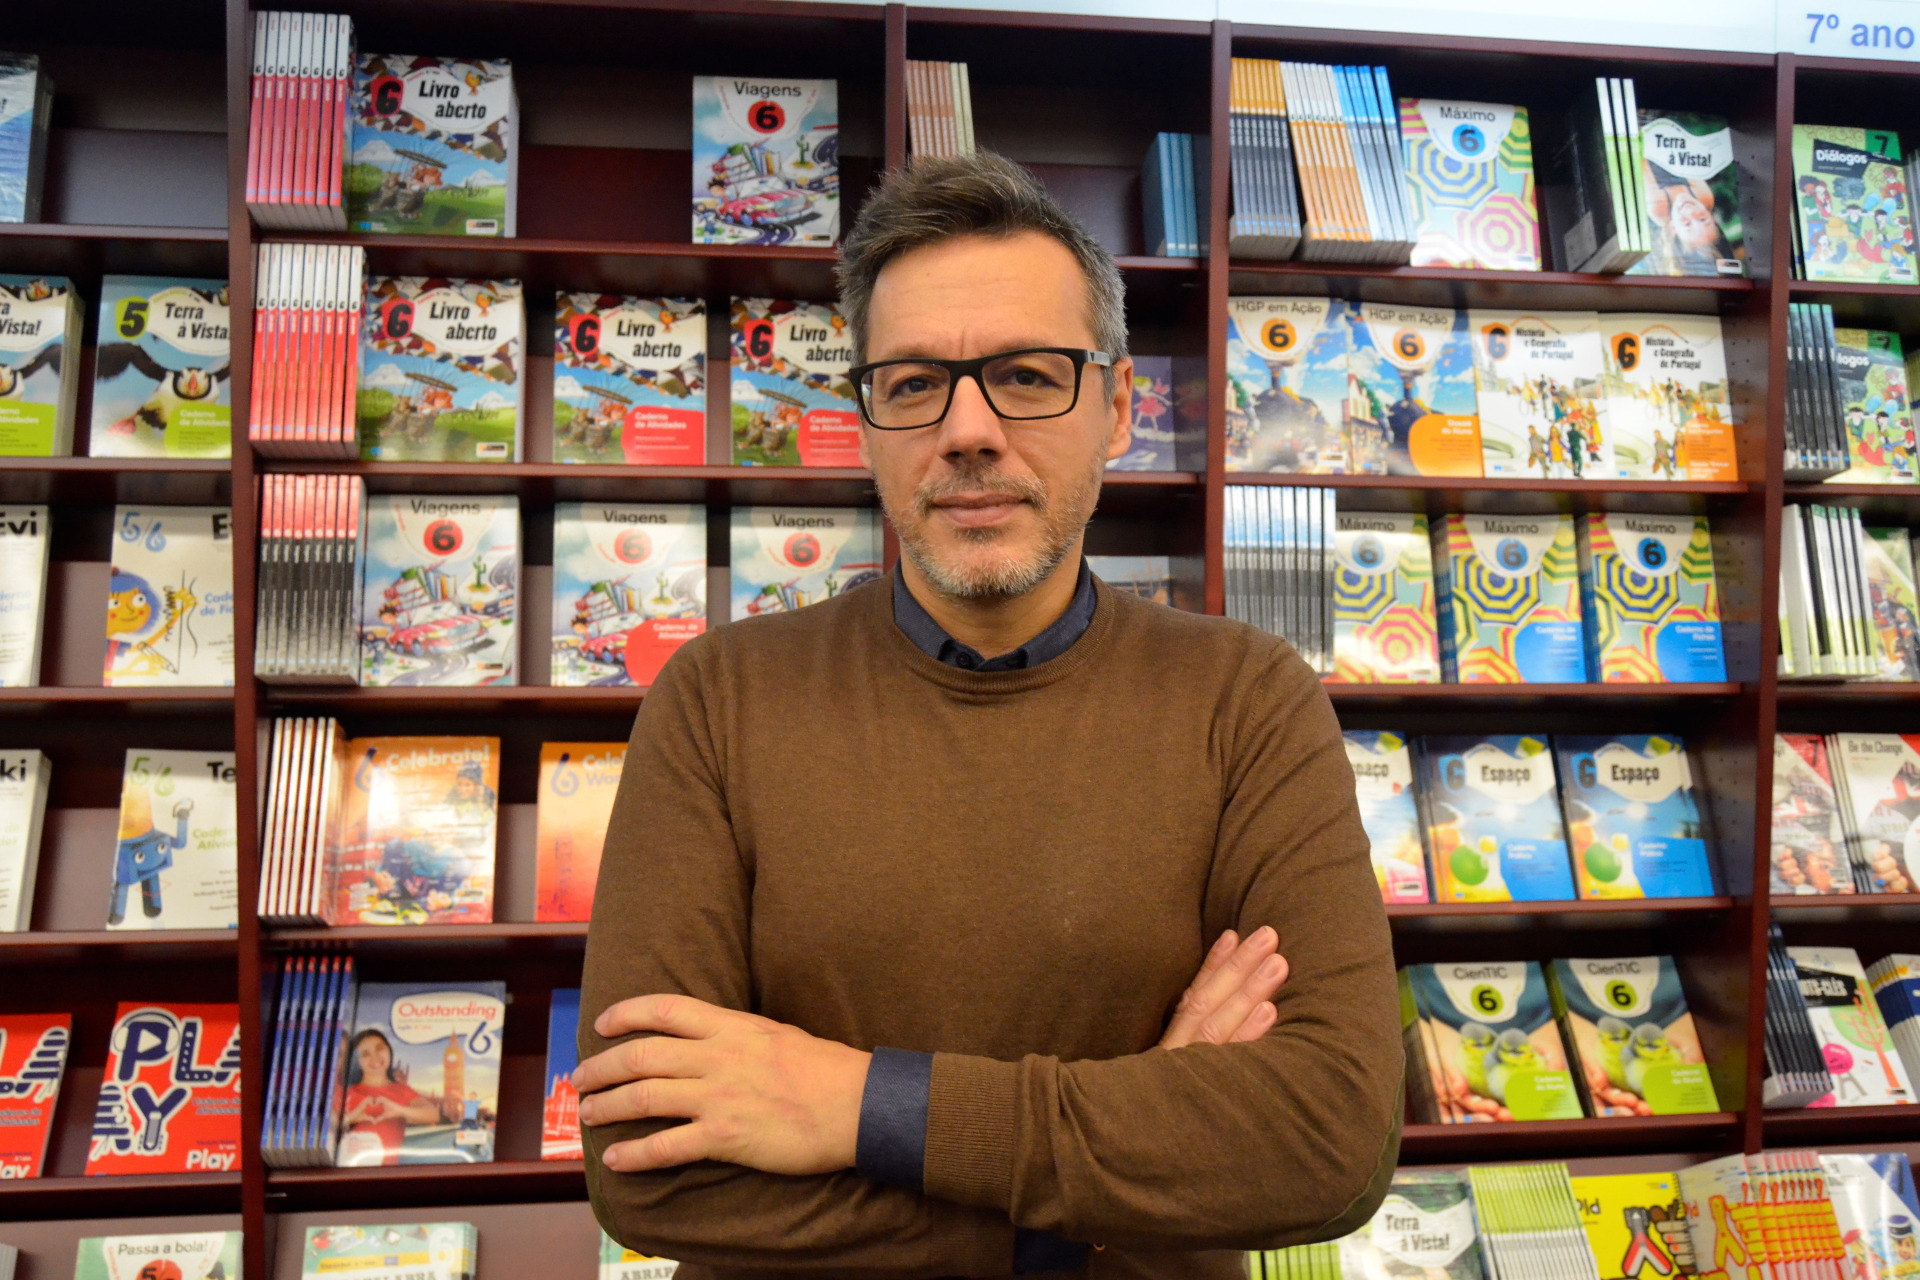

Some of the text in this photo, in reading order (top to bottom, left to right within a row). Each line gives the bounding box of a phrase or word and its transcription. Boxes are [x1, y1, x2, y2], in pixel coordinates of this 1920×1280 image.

[1806, 13, 1915, 49] 7º ano
[376, 81, 403, 115] 6
[419, 81, 460, 98] Livro
[734, 81, 802, 99] Viagens
[435, 103, 487, 119] aberto
[756, 106, 779, 129] 6
[1440, 106, 1495, 122] Máximo
[1459, 129, 1478, 152] 6
[1655, 134, 1686, 149] Terra
[1875, 135, 1889, 156] 7
[1678, 152, 1712, 167] Vista!
[1815, 149, 1868, 166] Diálogos
[165, 303, 204, 320] Terra
[429, 302, 470, 320] Livro
[1235, 301, 1322, 315] HGP em Ação
[1369, 309, 1448, 325] HGP em Ação
[120, 302, 149, 337] 5
[387, 303, 412, 338] 6
[177, 322, 187, 338] à
[445, 323, 497, 340] aberto
[576, 320, 598, 354] 6
[617, 320, 655, 338] Livro
[790, 325, 827, 342] Livro
[1269, 324, 1290, 348] 6
[1516, 327, 1545, 337] História
[633, 341, 682, 358] aberto
[750, 324, 772, 358] 6
[1400, 333, 1419, 357] 6
[1488, 328, 1507, 359] 6
[1531, 338, 1567, 351] Geografia
[1646, 337, 1675, 347] História
[1542, 350, 1574, 362] Portugal
[1618, 338, 1637, 369] 6
[1661, 348, 1695, 361] Geografia
[1660, 359, 1702, 371] de Portugal
[634, 412, 669, 421] Caderno
[411, 499, 481, 518] Viagens
[603, 510, 668, 524] Viagens
[772, 514, 835, 528] Viagens
[1340, 518, 1396, 531] Máximo
[1484, 520, 1539, 534] Máximo
[1625, 520, 1676, 534] Máximo
[432, 525, 456, 551] 6
[622, 534, 645, 561] 6
[792, 536, 814, 563] 6
[1359, 540, 1379, 564] 6
[1502, 543, 1523, 567] 6
[1644, 542, 1662, 566] 6
[200, 606, 215, 617] de
[1808, 739, 1820, 767] 7
[1848, 741, 1859, 753] Be
[1861, 741, 1873, 753] the
[386, 746, 489, 772] Celebrate!
[551, 753, 580, 797] 6
[1447, 759, 1466, 790] 6
[1482, 766, 1531, 786] Espaço
[1578, 758, 1597, 789] 6
[1612, 764, 1660, 786] Espaço
[1454, 966, 1508, 981] CienTIC
[1587, 961, 1641, 975] CienTIC
[1478, 989, 1497, 1012] 6
[1612, 985, 1631, 1007] 6
[398, 1002, 497, 1021] Outstanding
[469, 1021, 491, 1055] 6
[187, 1149, 235, 1171] Play
[1385, 1214, 1420, 1231] Terra
[118, 1240, 208, 1256] Passa a bola!
[428, 1228, 457, 1270] 6
[1409, 1234, 1450, 1252] Vista!
